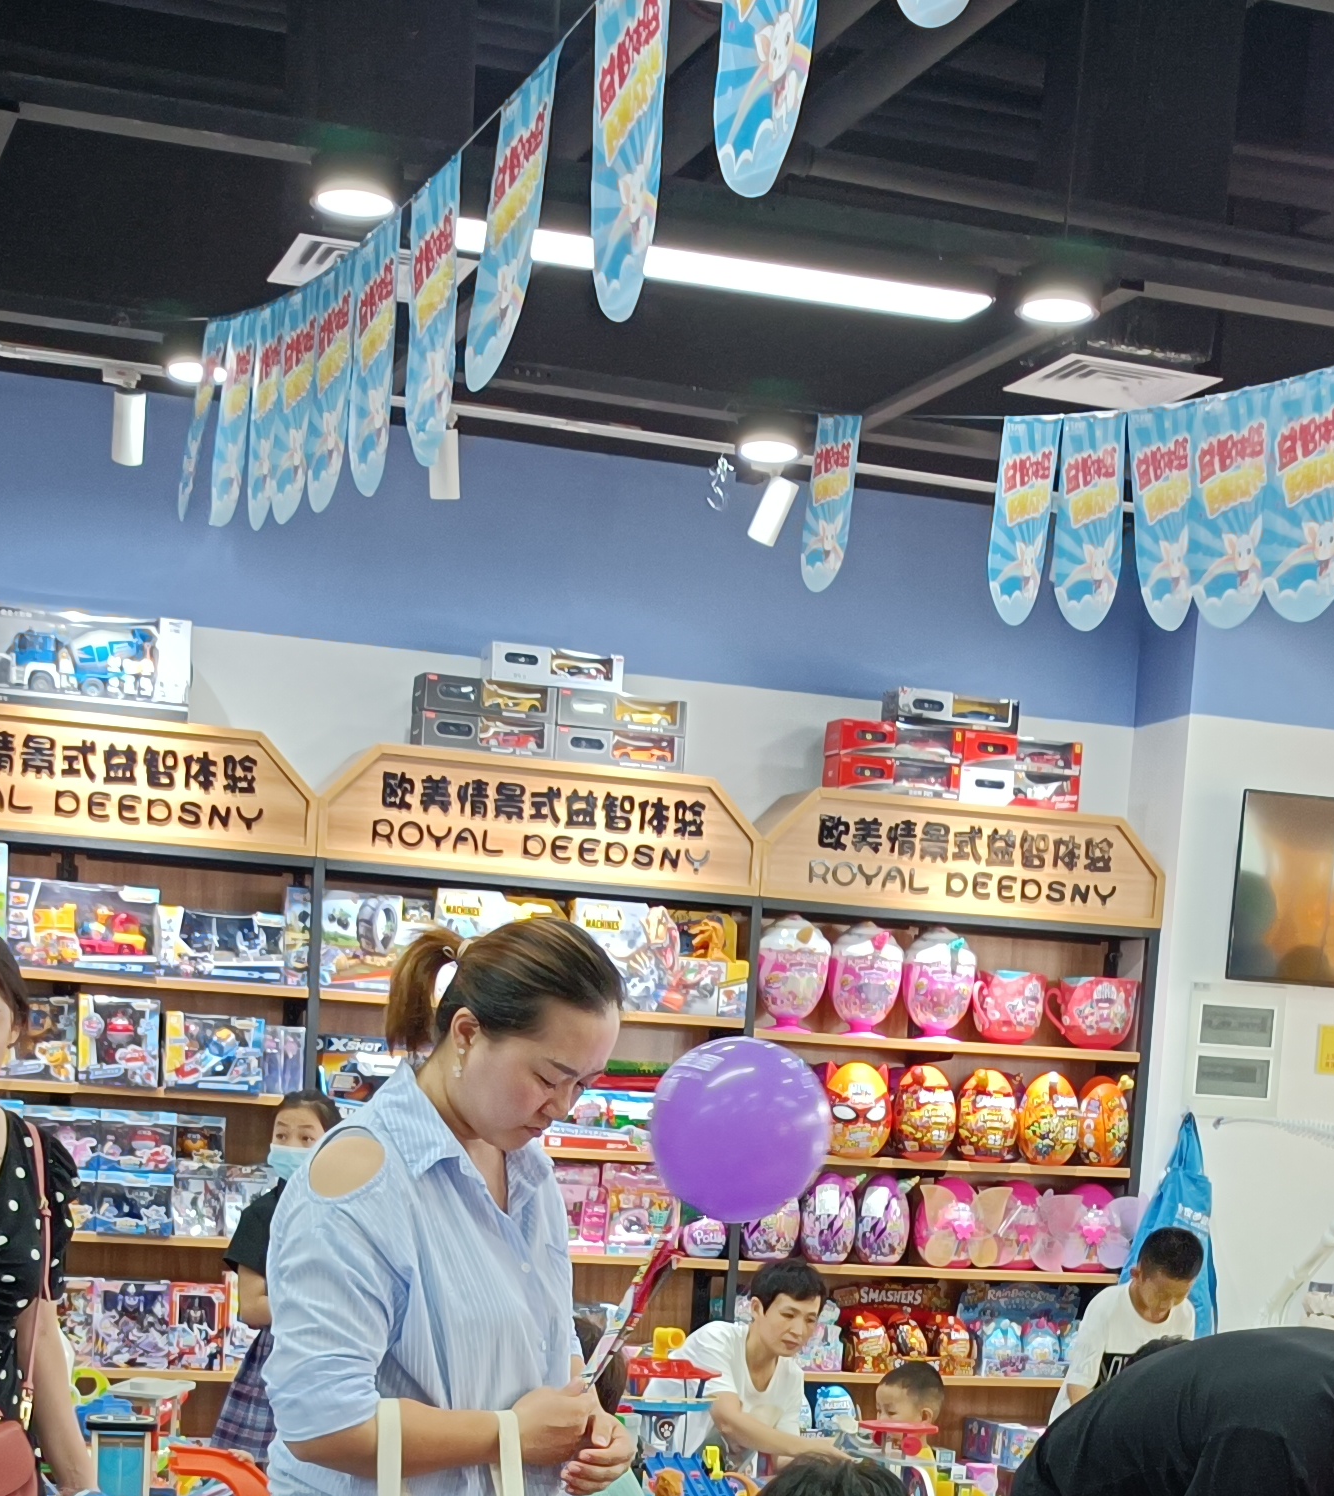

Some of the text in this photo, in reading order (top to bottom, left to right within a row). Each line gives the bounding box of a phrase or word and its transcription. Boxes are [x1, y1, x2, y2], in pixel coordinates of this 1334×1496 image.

[54, 789, 264, 831] DEEDSNY
[382, 771, 707, 838] 欧美情景式益智体验
[371, 818, 711, 873] ROYAL DEEDSNY
[817, 813, 1113, 873] 欧美情景式益智体验
[808, 859, 1117, 906] ROYAL DEEDSNY
[860, 1287, 923, 1305] SMASHERS
